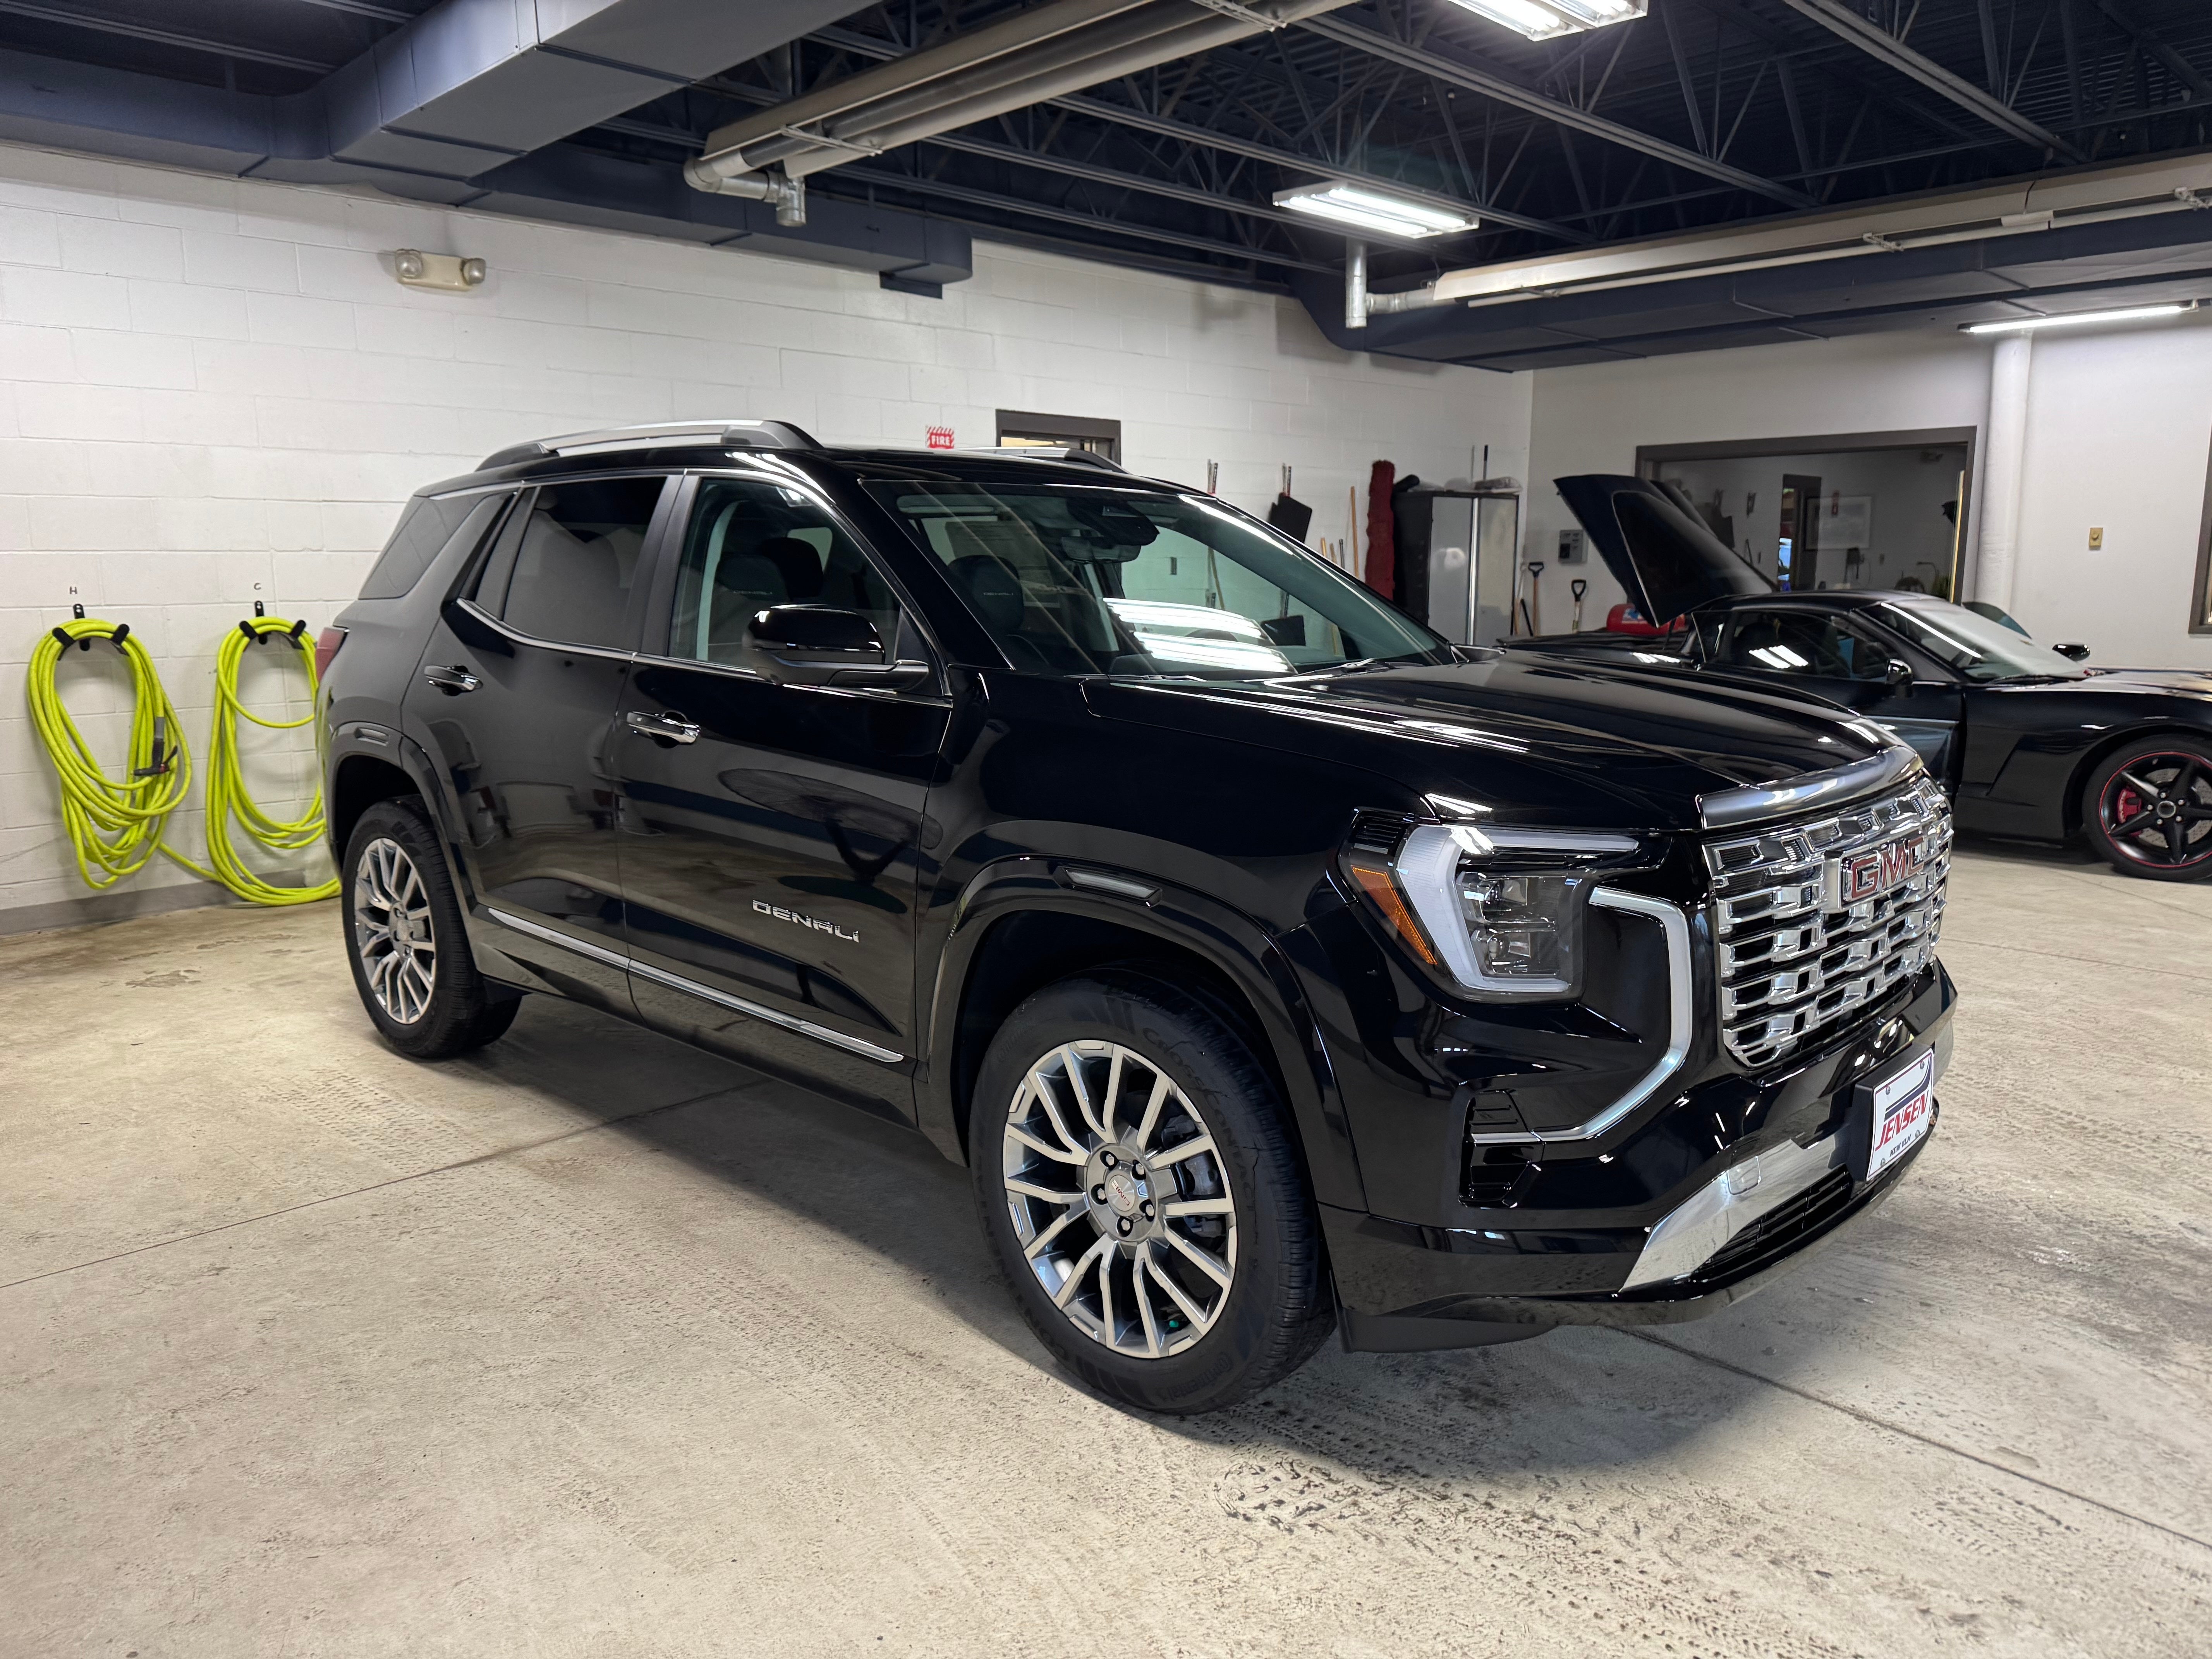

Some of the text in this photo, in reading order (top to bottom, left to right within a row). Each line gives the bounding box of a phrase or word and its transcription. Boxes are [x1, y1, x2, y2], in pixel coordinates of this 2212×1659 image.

[931, 435, 950, 446] FIRE
[70, 586, 77, 594] H
[1851, 837, 1925, 898] GMC
[752, 899, 860, 943] DENALI
[1875, 1090, 1929, 1151] JENSEN
[1111, 1180, 1130, 1206] GMC
